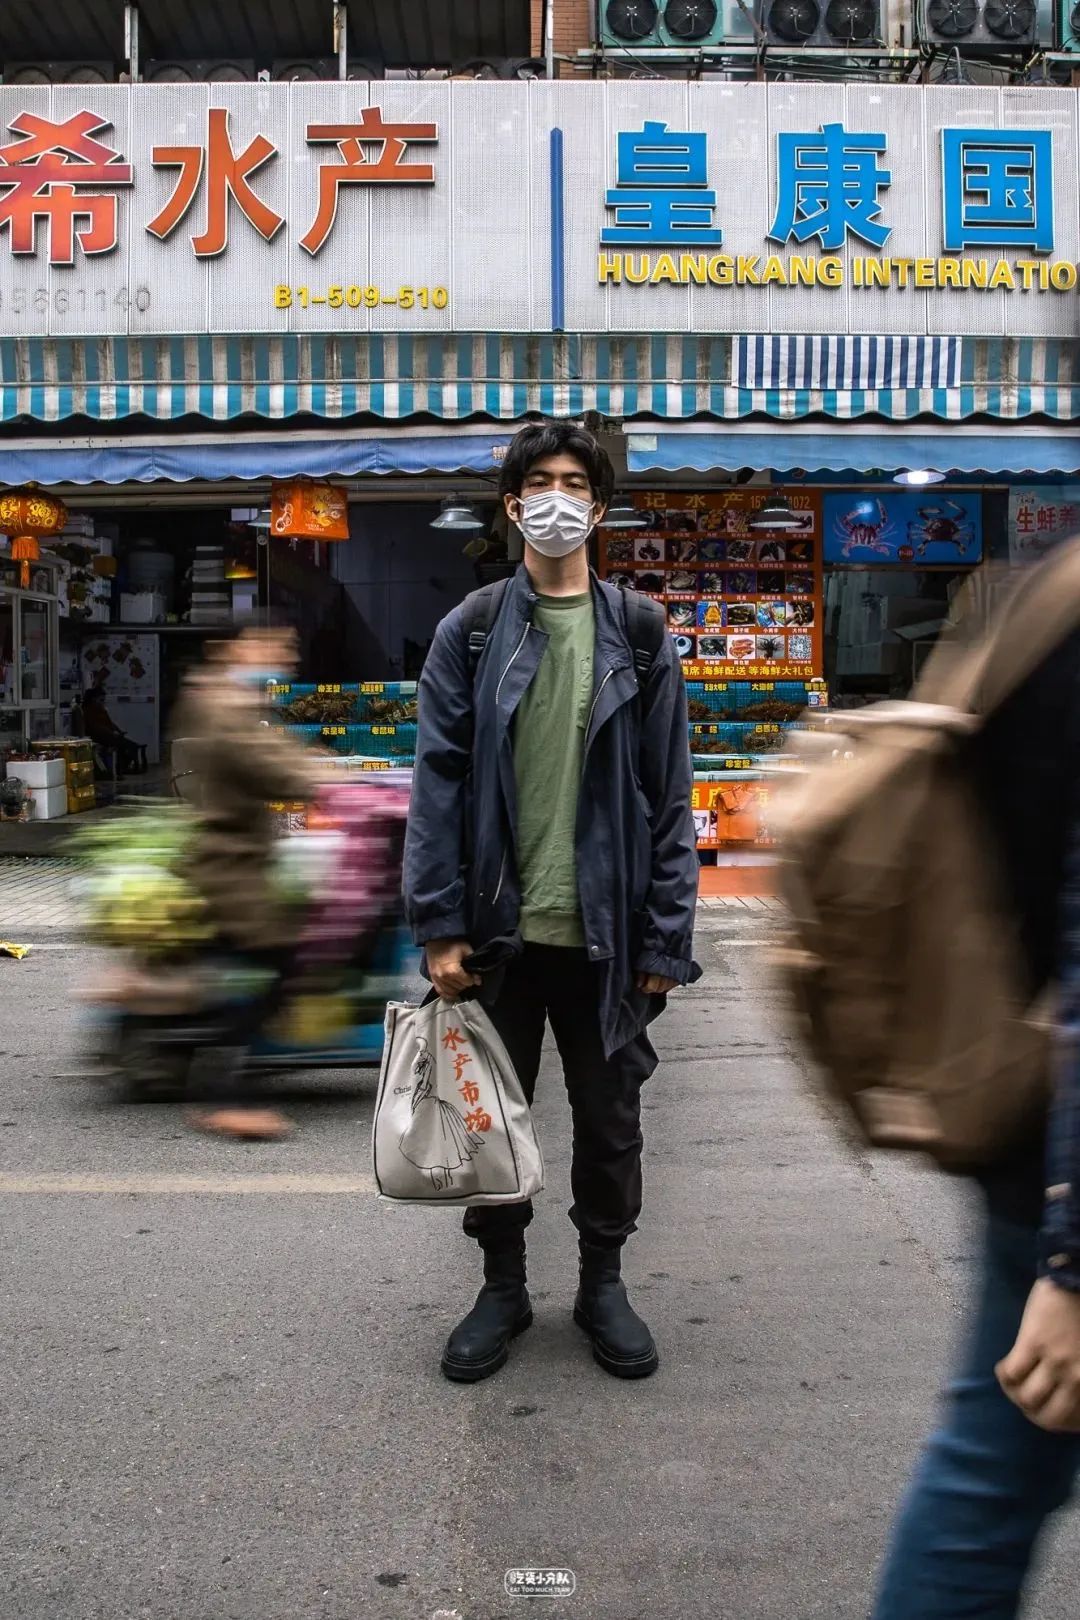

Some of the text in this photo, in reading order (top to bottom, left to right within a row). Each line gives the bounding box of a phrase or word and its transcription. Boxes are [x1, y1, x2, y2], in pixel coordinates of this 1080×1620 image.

[0, 106, 439, 265] 希水产
[600, 120, 1056, 253] 皇康国
[274, 284, 449, 310] B1-509-510
[598, 252, 1078, 292] HUANGKANG INTERNATIO
[702, 665, 747, 676] 海鲜配送
[442, 1026, 492, 1133] 水产市场
